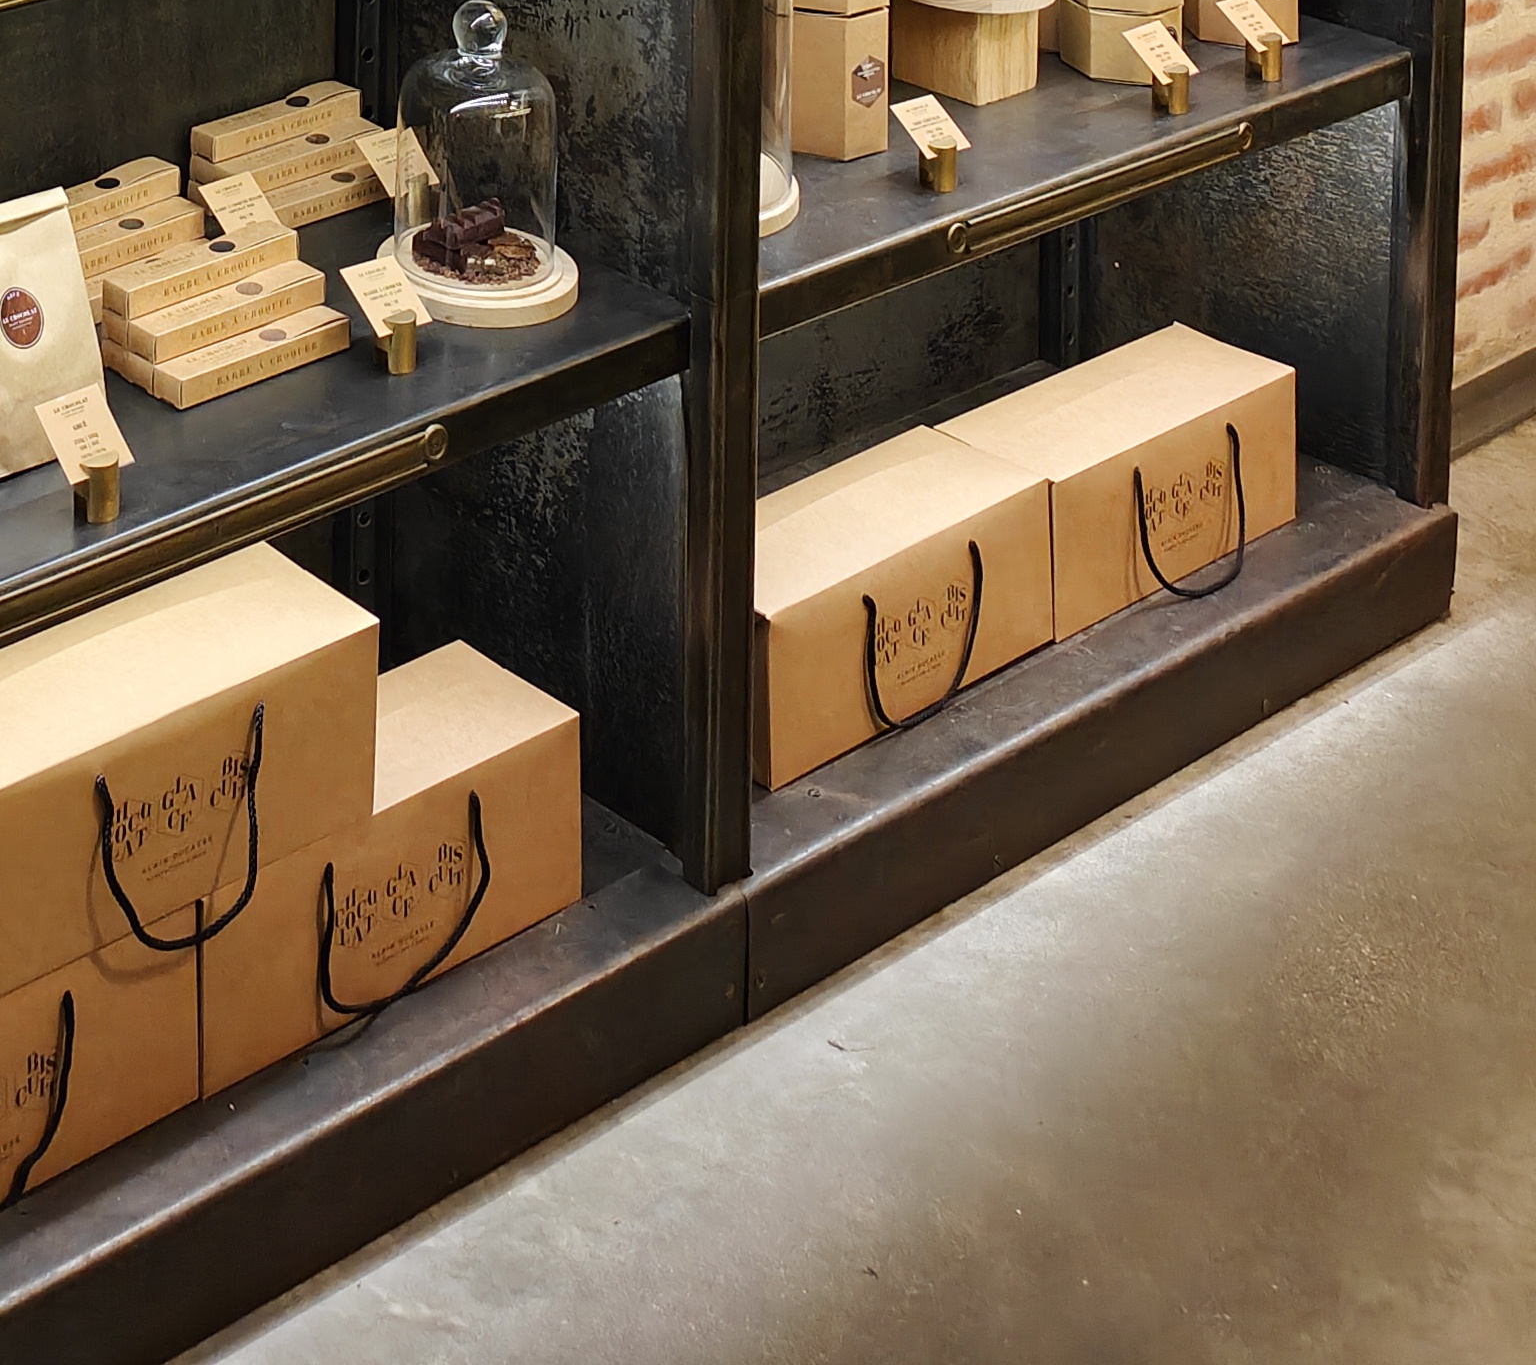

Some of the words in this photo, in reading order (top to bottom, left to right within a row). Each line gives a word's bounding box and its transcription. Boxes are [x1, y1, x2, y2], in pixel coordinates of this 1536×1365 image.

[245, 128, 276, 144] BARRE
[290, 110, 333, 131] CROQUER
[268, 167, 298, 182] BARRE
[314, 148, 356, 168] CROQUER
[104, 190, 149, 212] CROQUER
[293, 204, 324, 219] BARRE
[127, 233, 173, 255] CROQUER
[164, 279, 200, 297] BARRE
[217, 253, 265, 278] CROQUER
[9, 307, 37, 322] CHOCOLAT
[191, 323, 226, 341] BARRE
[244, 297, 292, 321] CROQUER
[217, 367, 252, 386] BARRE
[270, 342, 318, 366] CROQUER
[438, 843, 463, 864] BIS
[429, 865, 464, 893] CUIT
[27, 1051, 57, 1075] BIS
